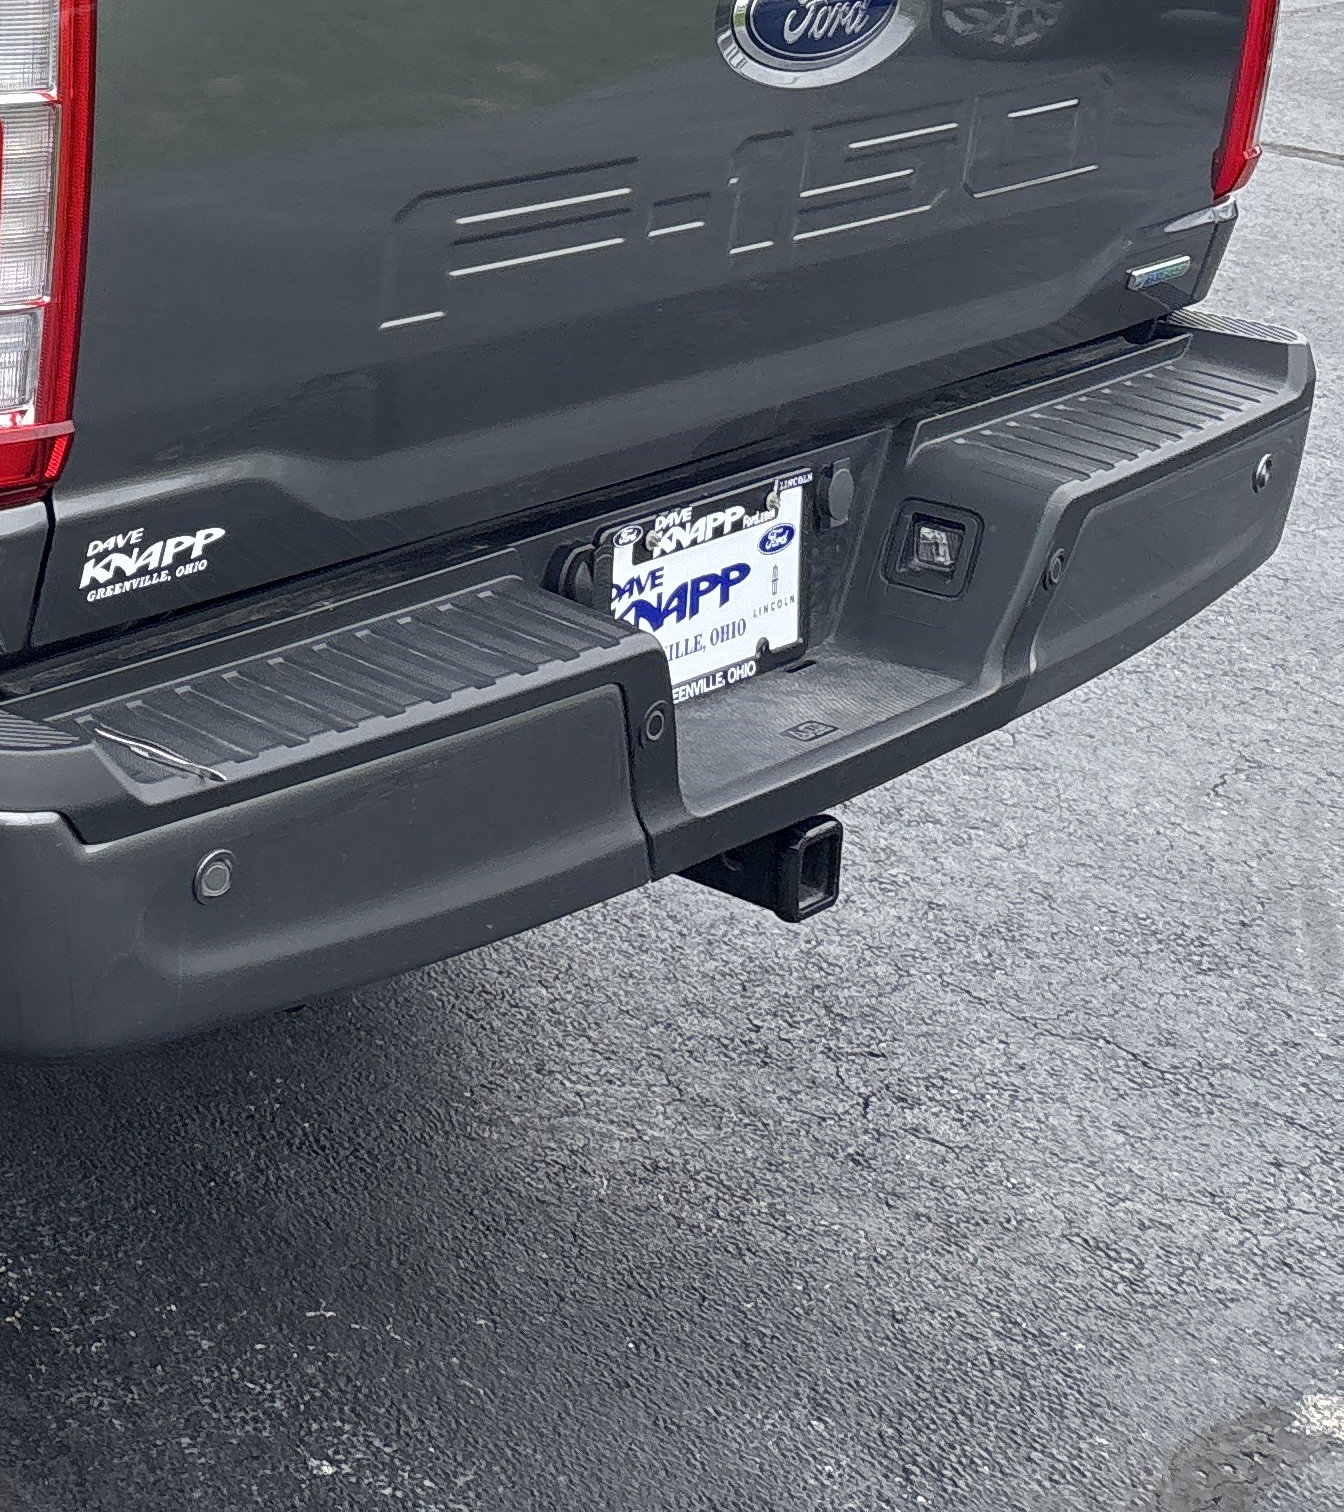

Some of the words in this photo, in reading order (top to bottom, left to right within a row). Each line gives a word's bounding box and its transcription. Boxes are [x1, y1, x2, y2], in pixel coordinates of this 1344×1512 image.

[379, 68, 1106, 329] F-150
[652, 505, 746, 558] KNAPP
[654, 506, 692, 532] DAVE
[86, 527, 145, 558] DAVE
[78, 527, 226, 590] KNAPP
[86, 570, 172, 602] GREENVILLE,
[175, 559, 208, 578] OHIO
[753, 593, 795, 619] LINCOLN
[709, 617, 747, 646] OHIO
[727, 660, 757, 684] OHIO
